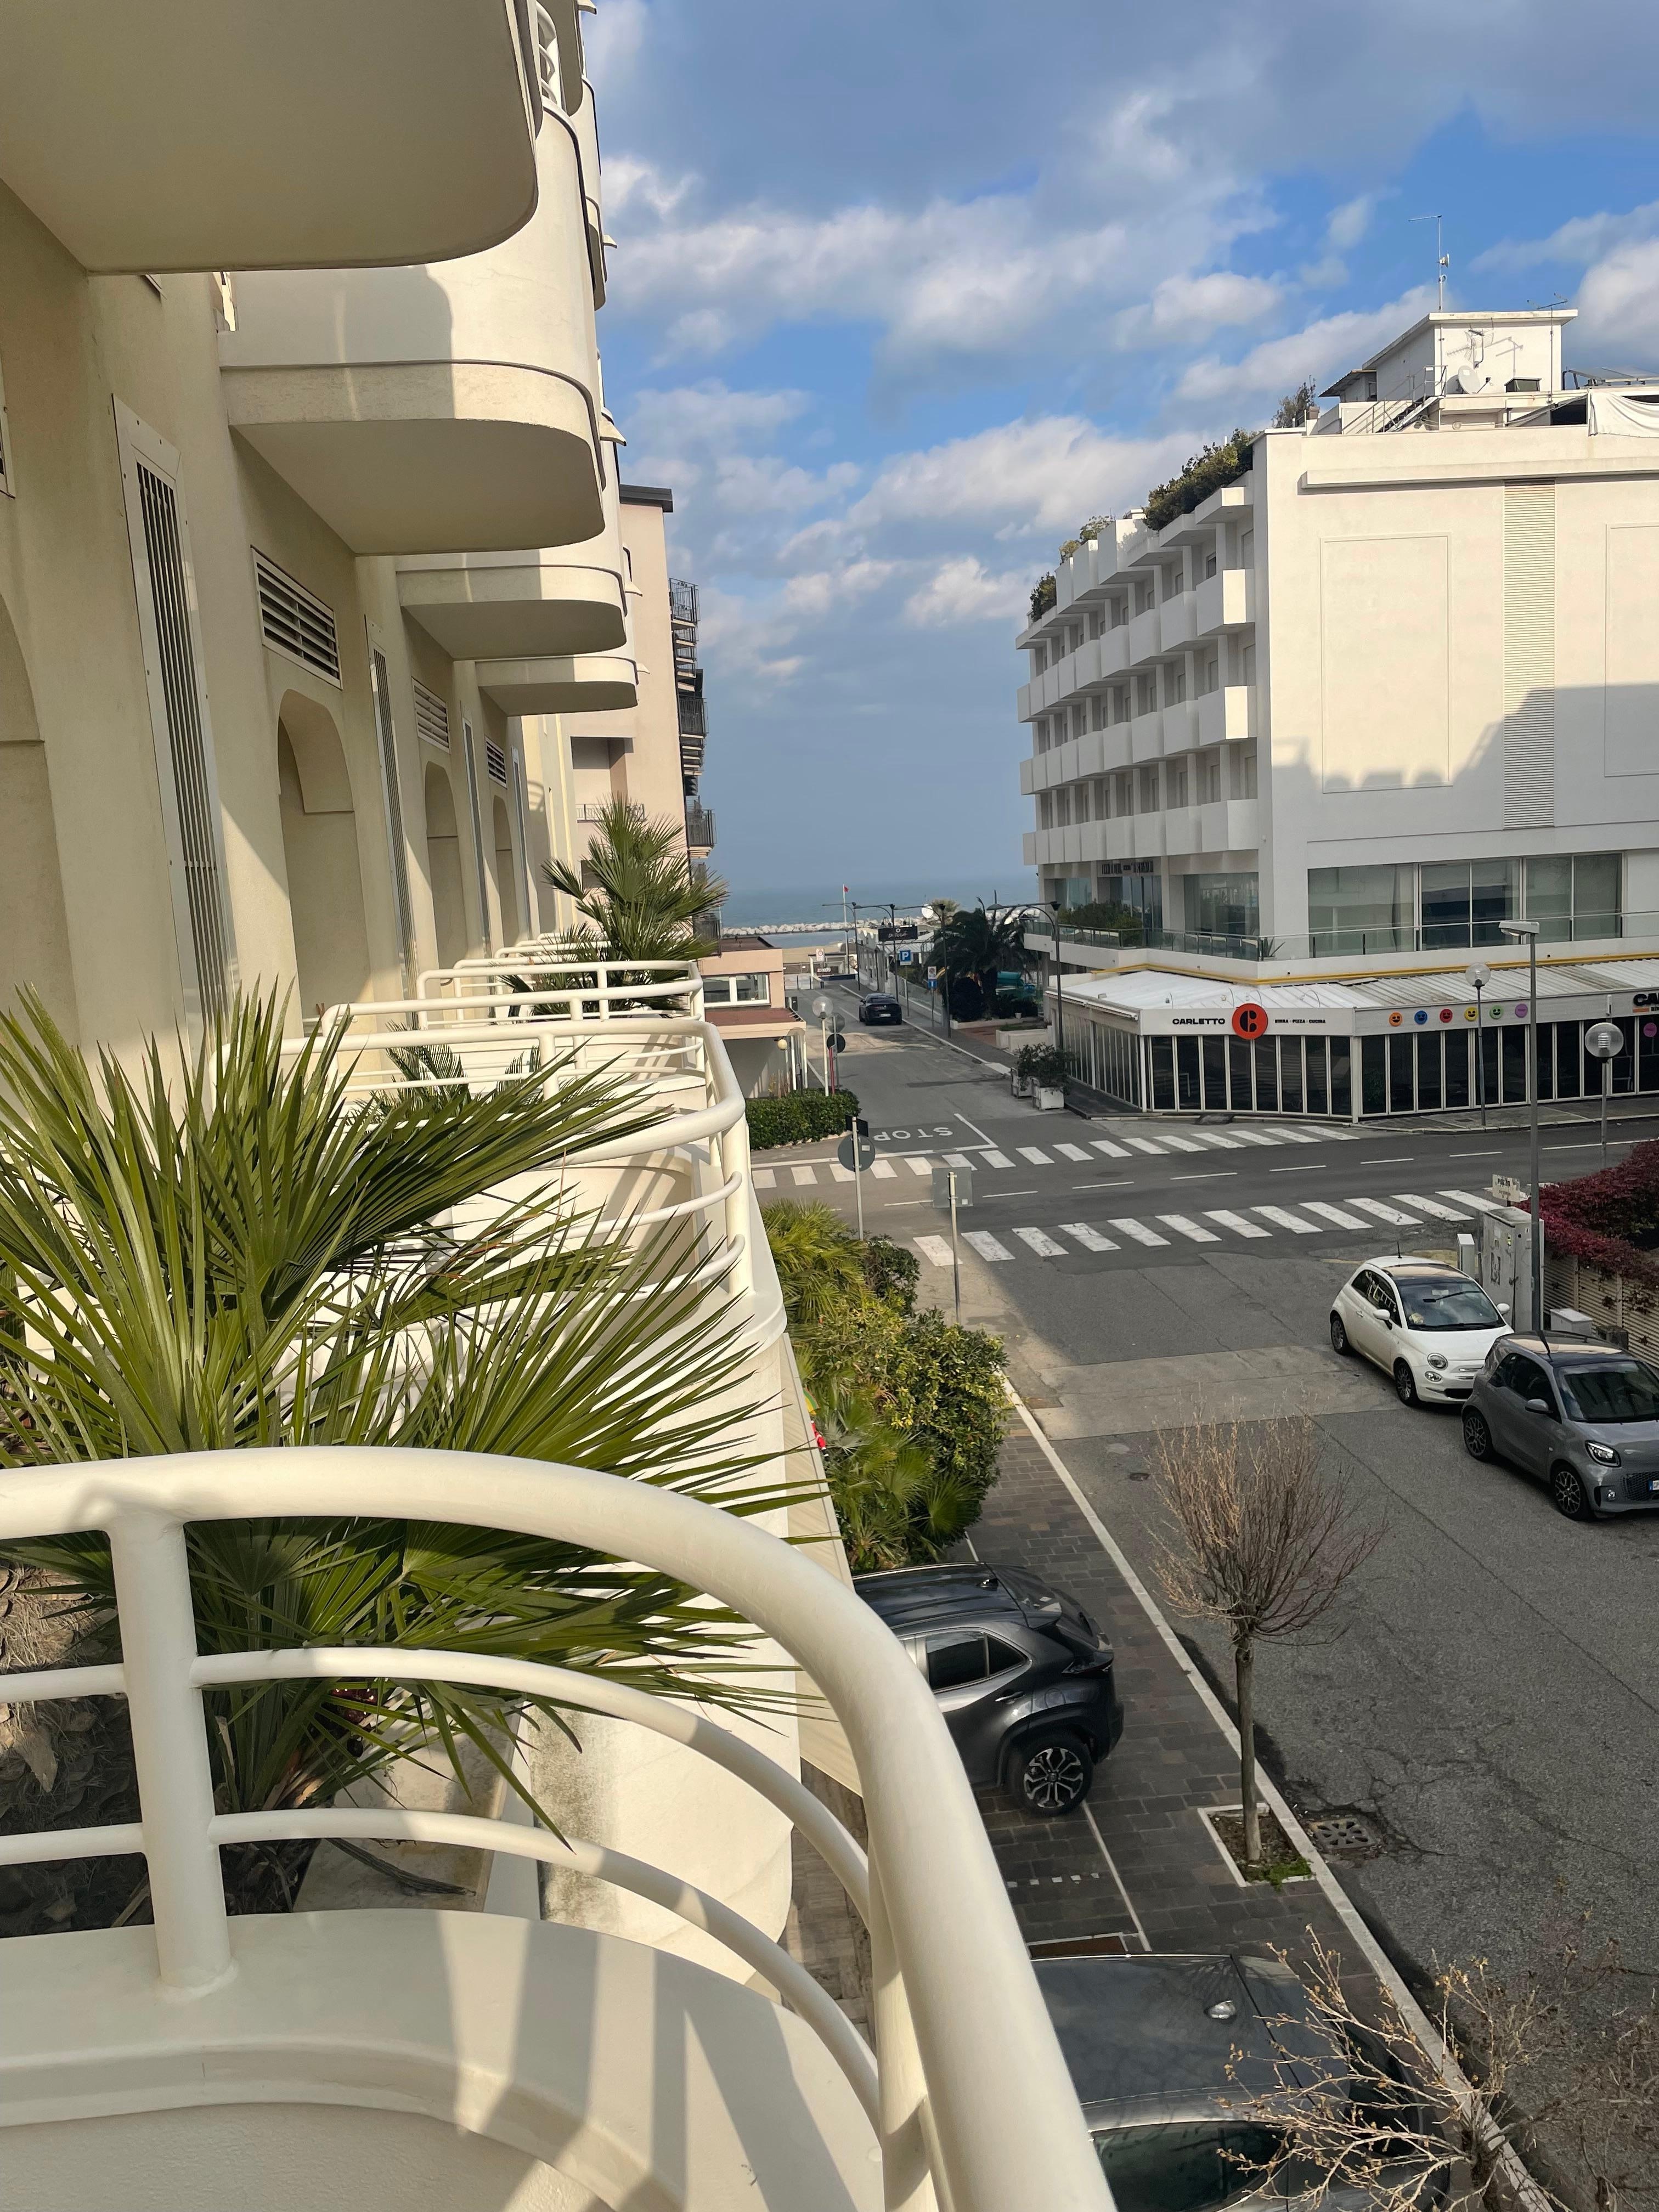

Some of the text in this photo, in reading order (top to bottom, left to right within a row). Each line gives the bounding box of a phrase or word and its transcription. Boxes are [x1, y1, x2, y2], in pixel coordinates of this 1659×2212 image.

[902, 951, 909, 961] P
[1633, 992, 1659, 1006] CA
[872, 1127, 953, 1141] STOP
